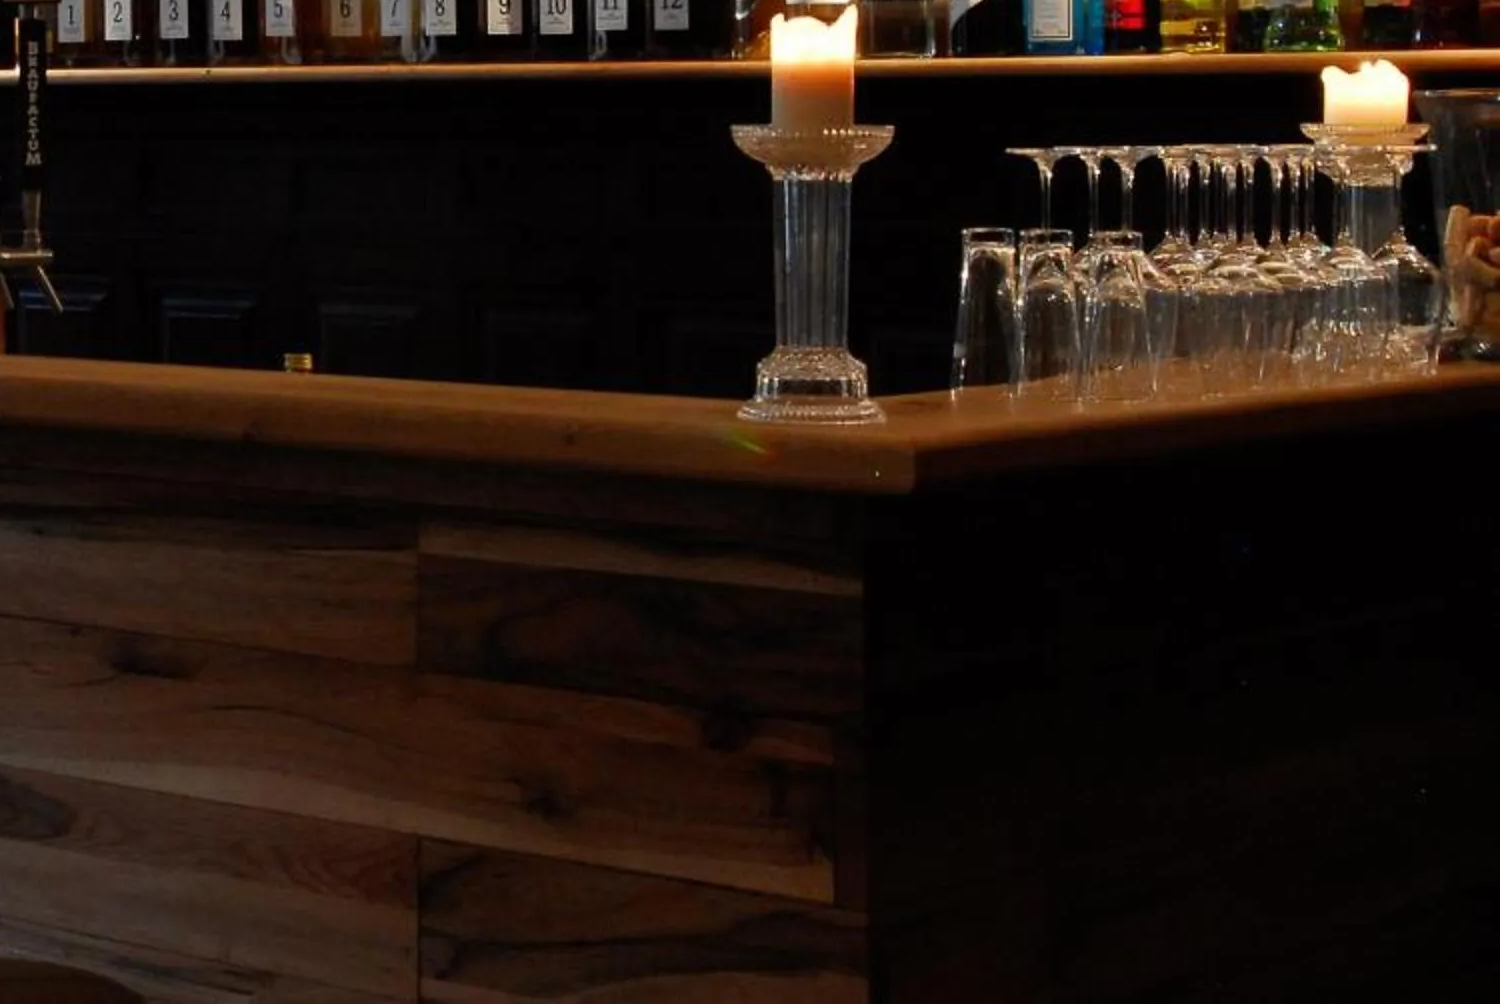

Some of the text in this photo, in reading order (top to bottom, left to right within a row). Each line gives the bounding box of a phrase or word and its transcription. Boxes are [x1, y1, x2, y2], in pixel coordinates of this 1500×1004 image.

[67, 5, 74, 25] 1
[113, 1, 123, 22] 2
[169, 0, 179, 21] 3
[220, 0, 230, 20] 4
